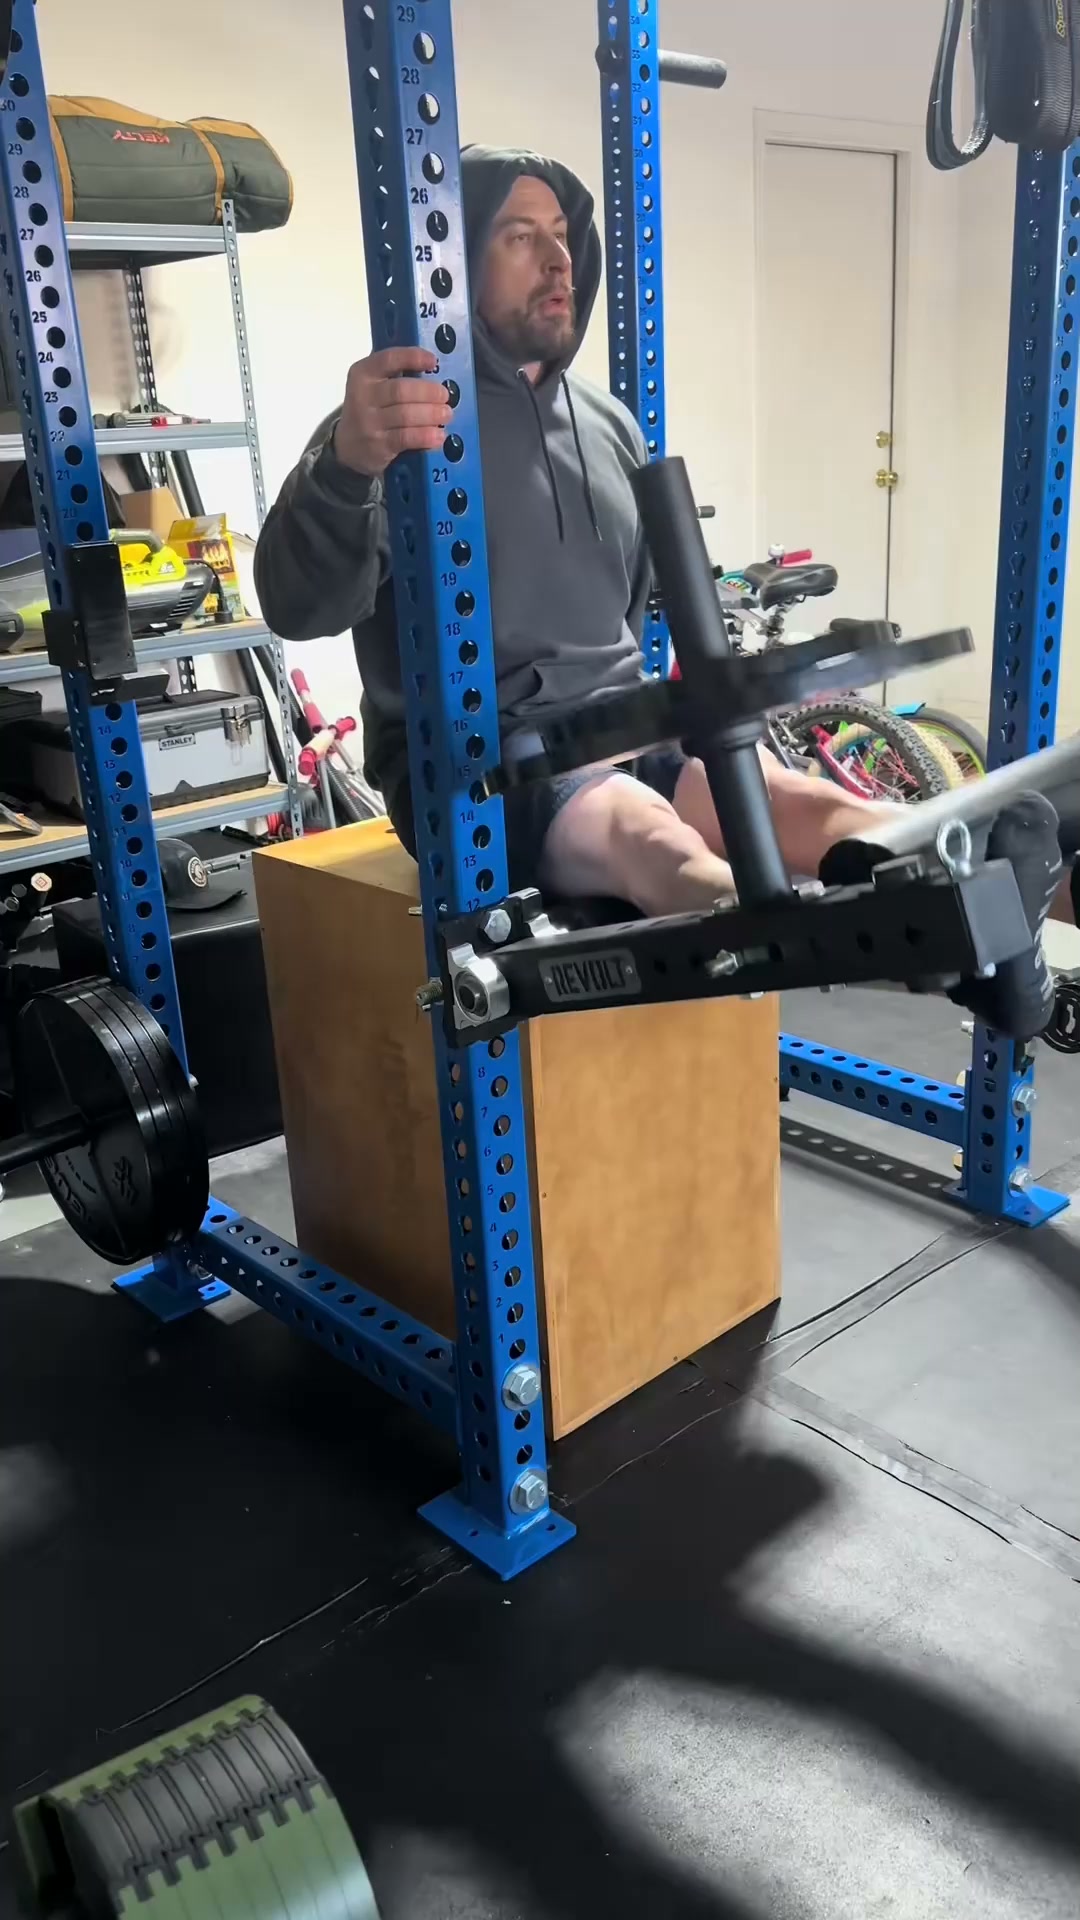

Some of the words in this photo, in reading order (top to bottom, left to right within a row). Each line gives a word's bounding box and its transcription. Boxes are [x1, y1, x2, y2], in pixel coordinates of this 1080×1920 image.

[397, 6, 415, 23] 29
[402, 67, 419, 85] 28
[406, 129, 424, 146] 27
[7, 142, 23, 155] 29
[13, 186, 29, 199] 28
[410, 188, 428, 204] 26
[19, 228, 35, 241] 27
[415, 245, 433, 262] 25
[26, 270, 42, 283] 26
[419, 302, 437, 319] 24
[32, 311, 48, 324] 25
[38, 352, 54, 364] 24
[44, 391, 59, 403] 23
[50, 431, 65, 442] 22
[55, 469, 70, 481] 21
[432, 467, 449, 483] 21
[63, 508, 77, 519] 20
[436, 520, 453, 536] 20
[440, 572, 457, 587] 19
[444, 622, 461, 637] 18
[448, 671, 464, 685] 17
[453, 719, 468, 733] 16
[161, 735, 193, 748] STANLEY
[460, 810, 475, 824] 14
[463, 854, 477, 868] 13
[466, 898, 481, 912] 12
[550, 955, 627, 997] REVOLT
[477, 1066, 486, 1079] 8
[480, 1106, 488, 1119] 7
[484, 1145, 492, 1158] 6
[487, 1184, 494, 1196] 5
[489, 1222, 497, 1233] 4
[492, 1260, 499, 1272] 3
[495, 1296, 503, 1308] 2
